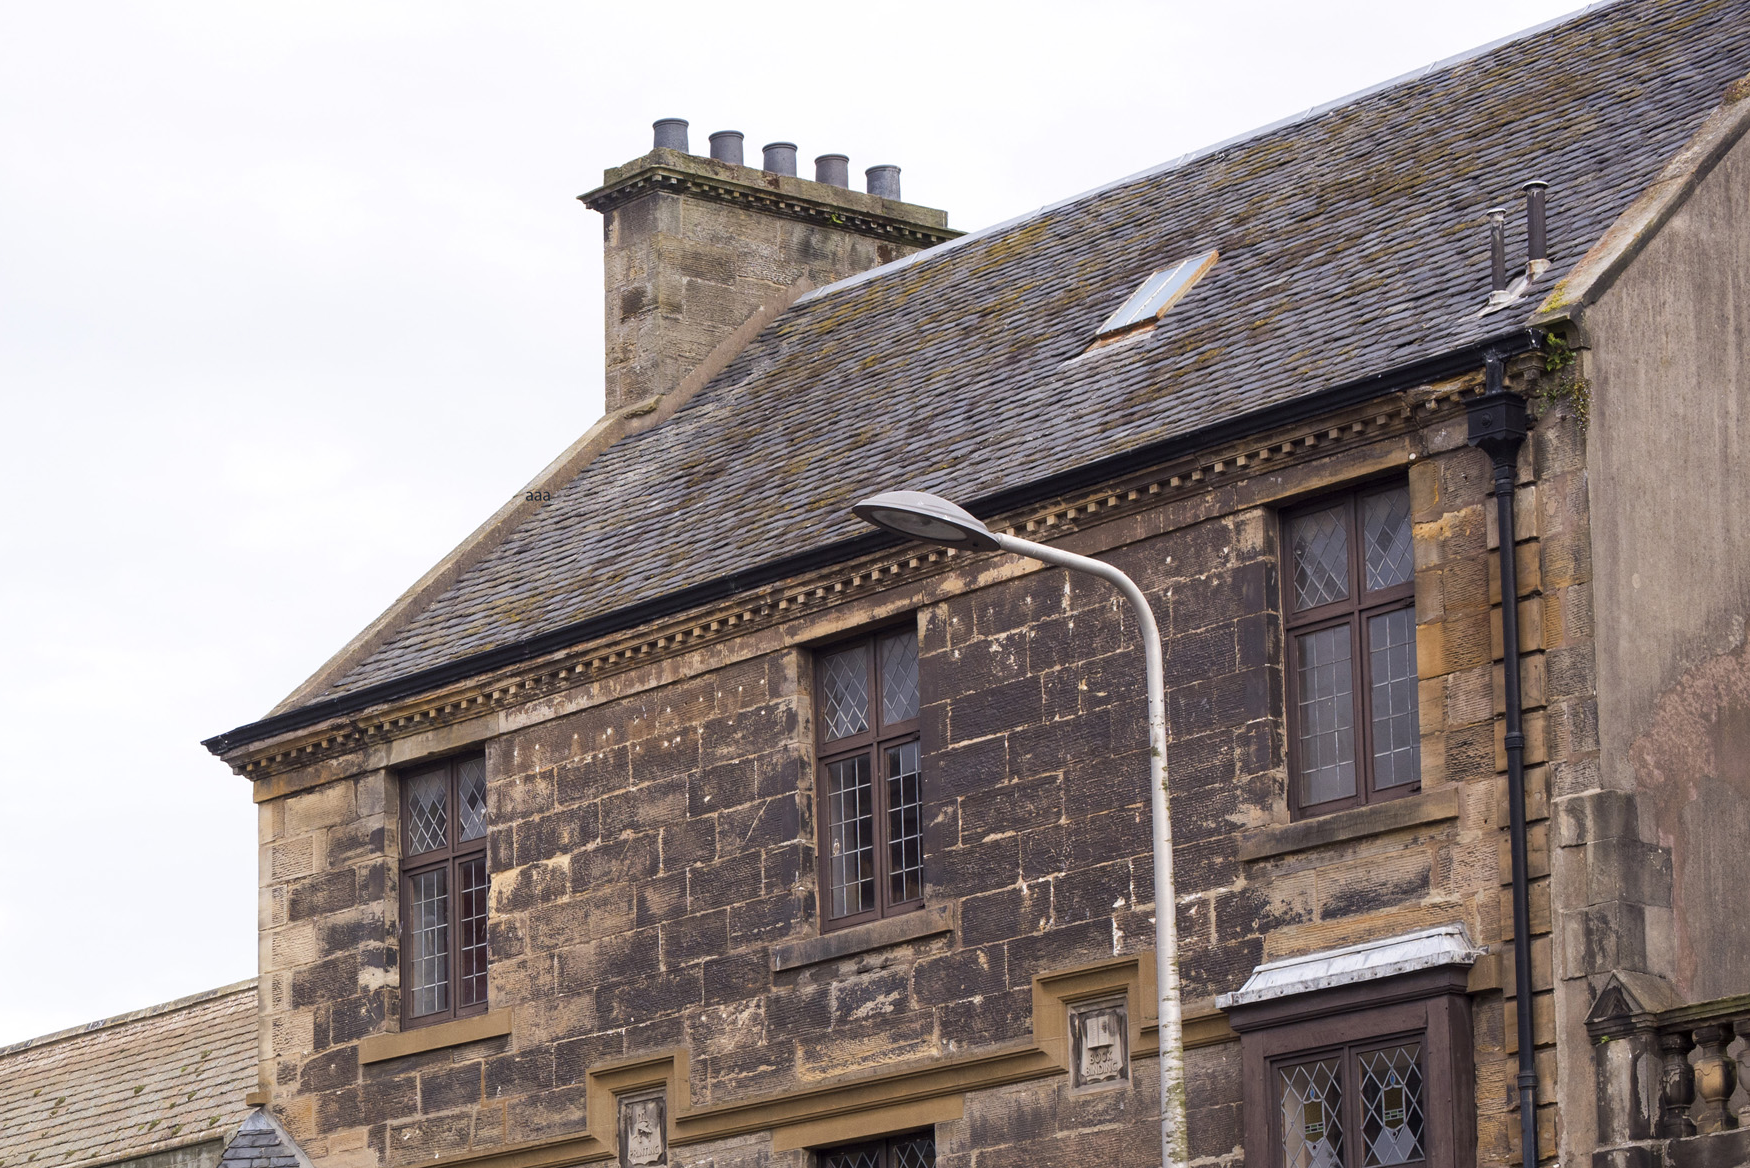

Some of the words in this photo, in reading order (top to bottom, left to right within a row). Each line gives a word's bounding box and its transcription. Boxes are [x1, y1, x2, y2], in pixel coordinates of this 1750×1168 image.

[1090, 1051, 1112, 1064] BOOK
[1085, 1062, 1118, 1077] BINDING
[630, 1145, 659, 1159] PRINTING
